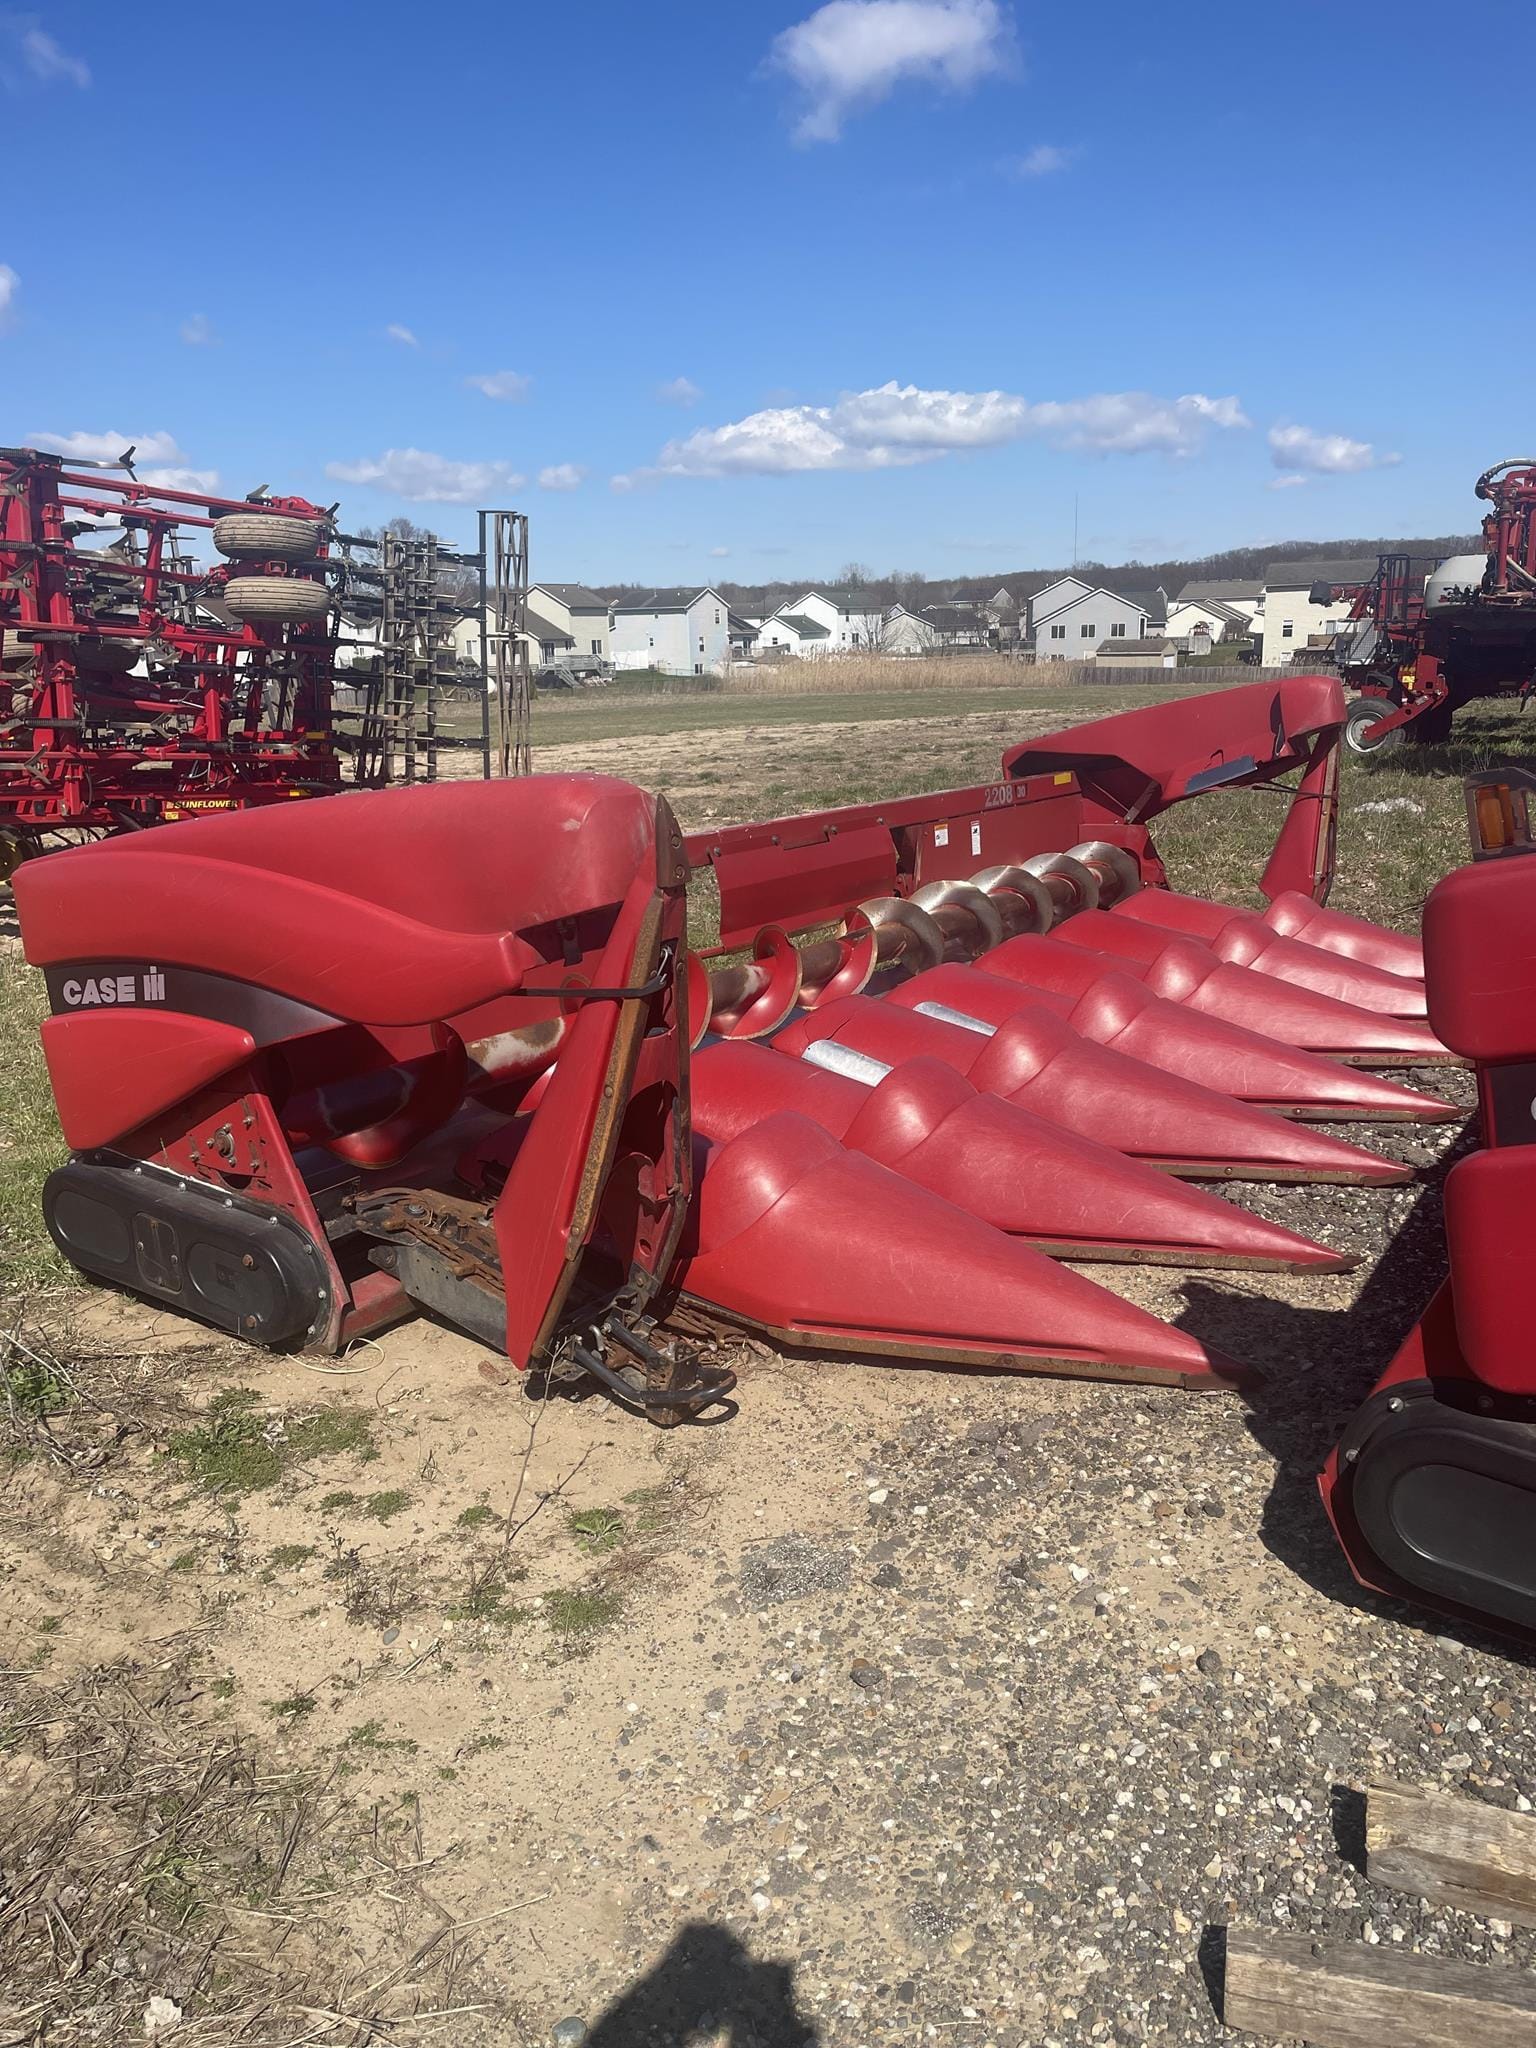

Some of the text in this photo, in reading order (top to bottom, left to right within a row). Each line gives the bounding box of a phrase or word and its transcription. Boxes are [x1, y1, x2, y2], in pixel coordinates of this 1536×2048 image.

[174, 800, 238, 809] SUNFLOWER
[984, 784, 1013, 807] 2208
[63, 976, 135, 1005] CASE
